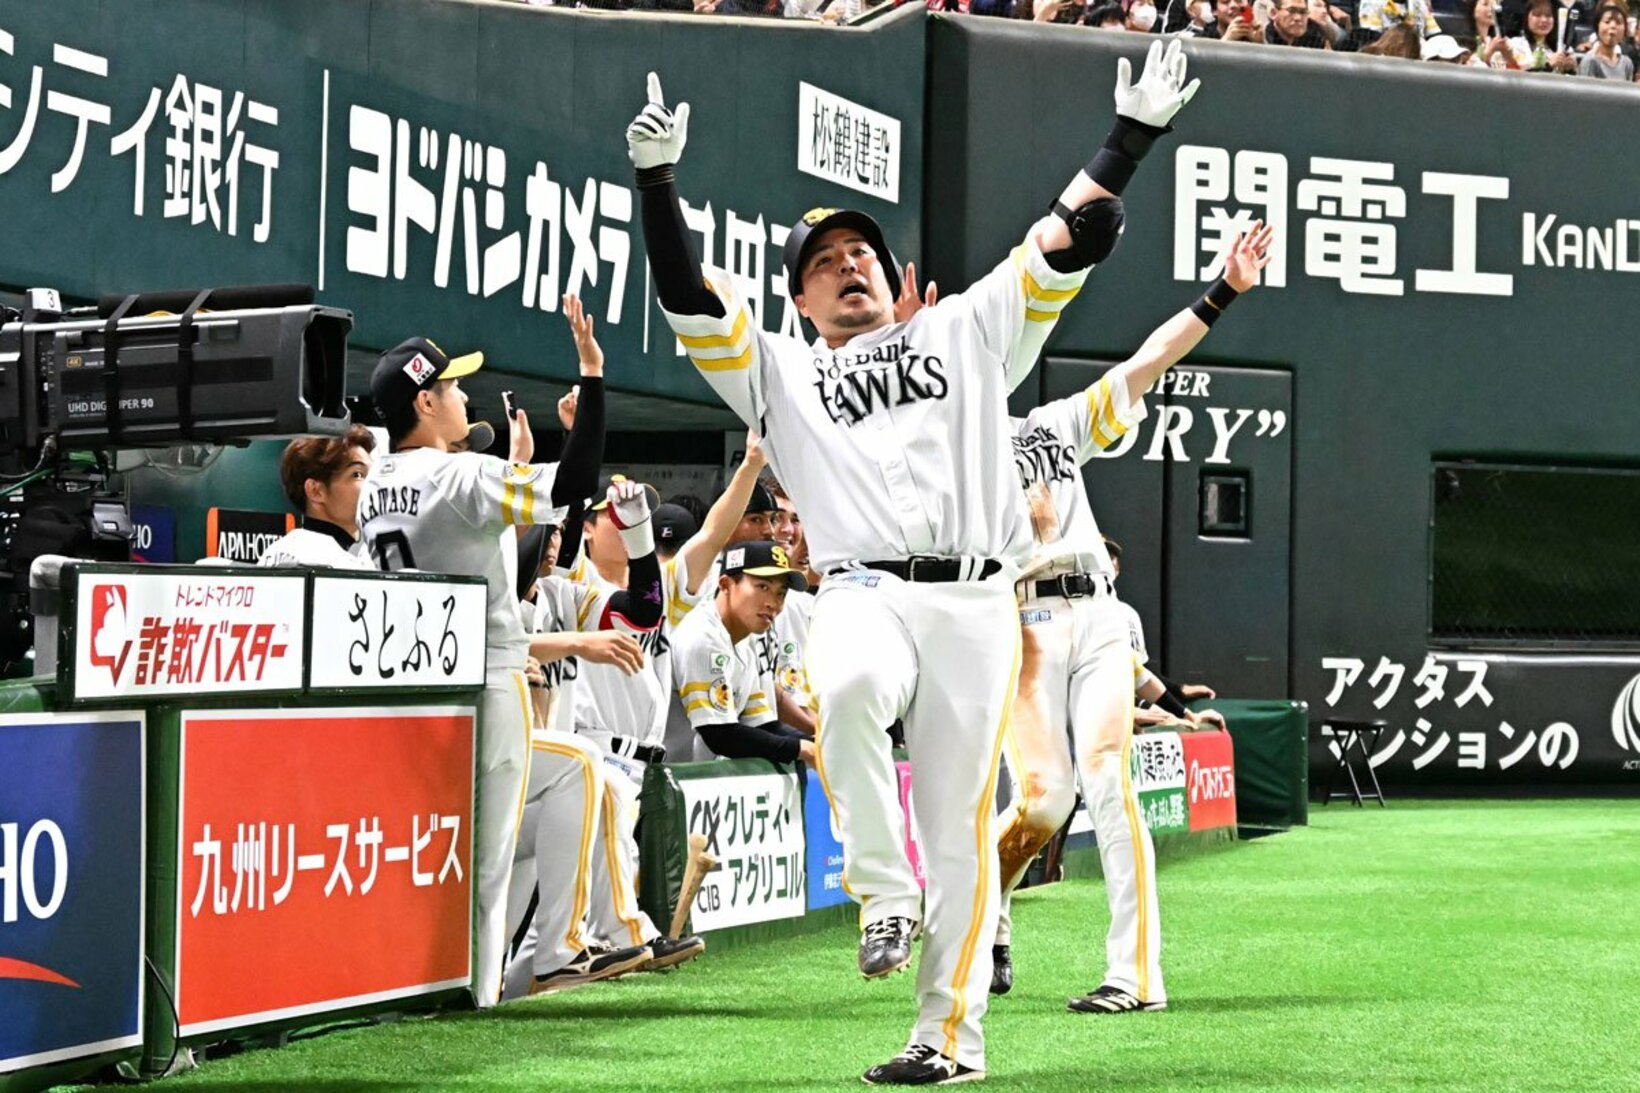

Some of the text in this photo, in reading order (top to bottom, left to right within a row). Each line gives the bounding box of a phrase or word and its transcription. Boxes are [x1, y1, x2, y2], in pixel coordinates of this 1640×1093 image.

[0, 29, 279, 243] シティ銀行
[811, 96, 890, 191] 松鶴建設
[346, 104, 632, 324] ヨドバシカメラ
[47, 290, 55, 308] 3
[68, 398, 154, 413] UHD DIGPER 90
[1145, 371, 1211, 397] PER
[245, 532, 282, 561] HOT
[175, 584, 254, 608] トレンドマイクロ
[134, 616, 289, 686] 詐欺バスター
[348, 590, 459, 679] さとふる
[1321, 656, 1494, 710] アクタス
[1321, 718, 1580, 770] マンションの
[191, 813, 463, 918] 九州リースサービス
[728, 852, 803, 908] アグリコル
[696, 883, 721, 914] CIB
